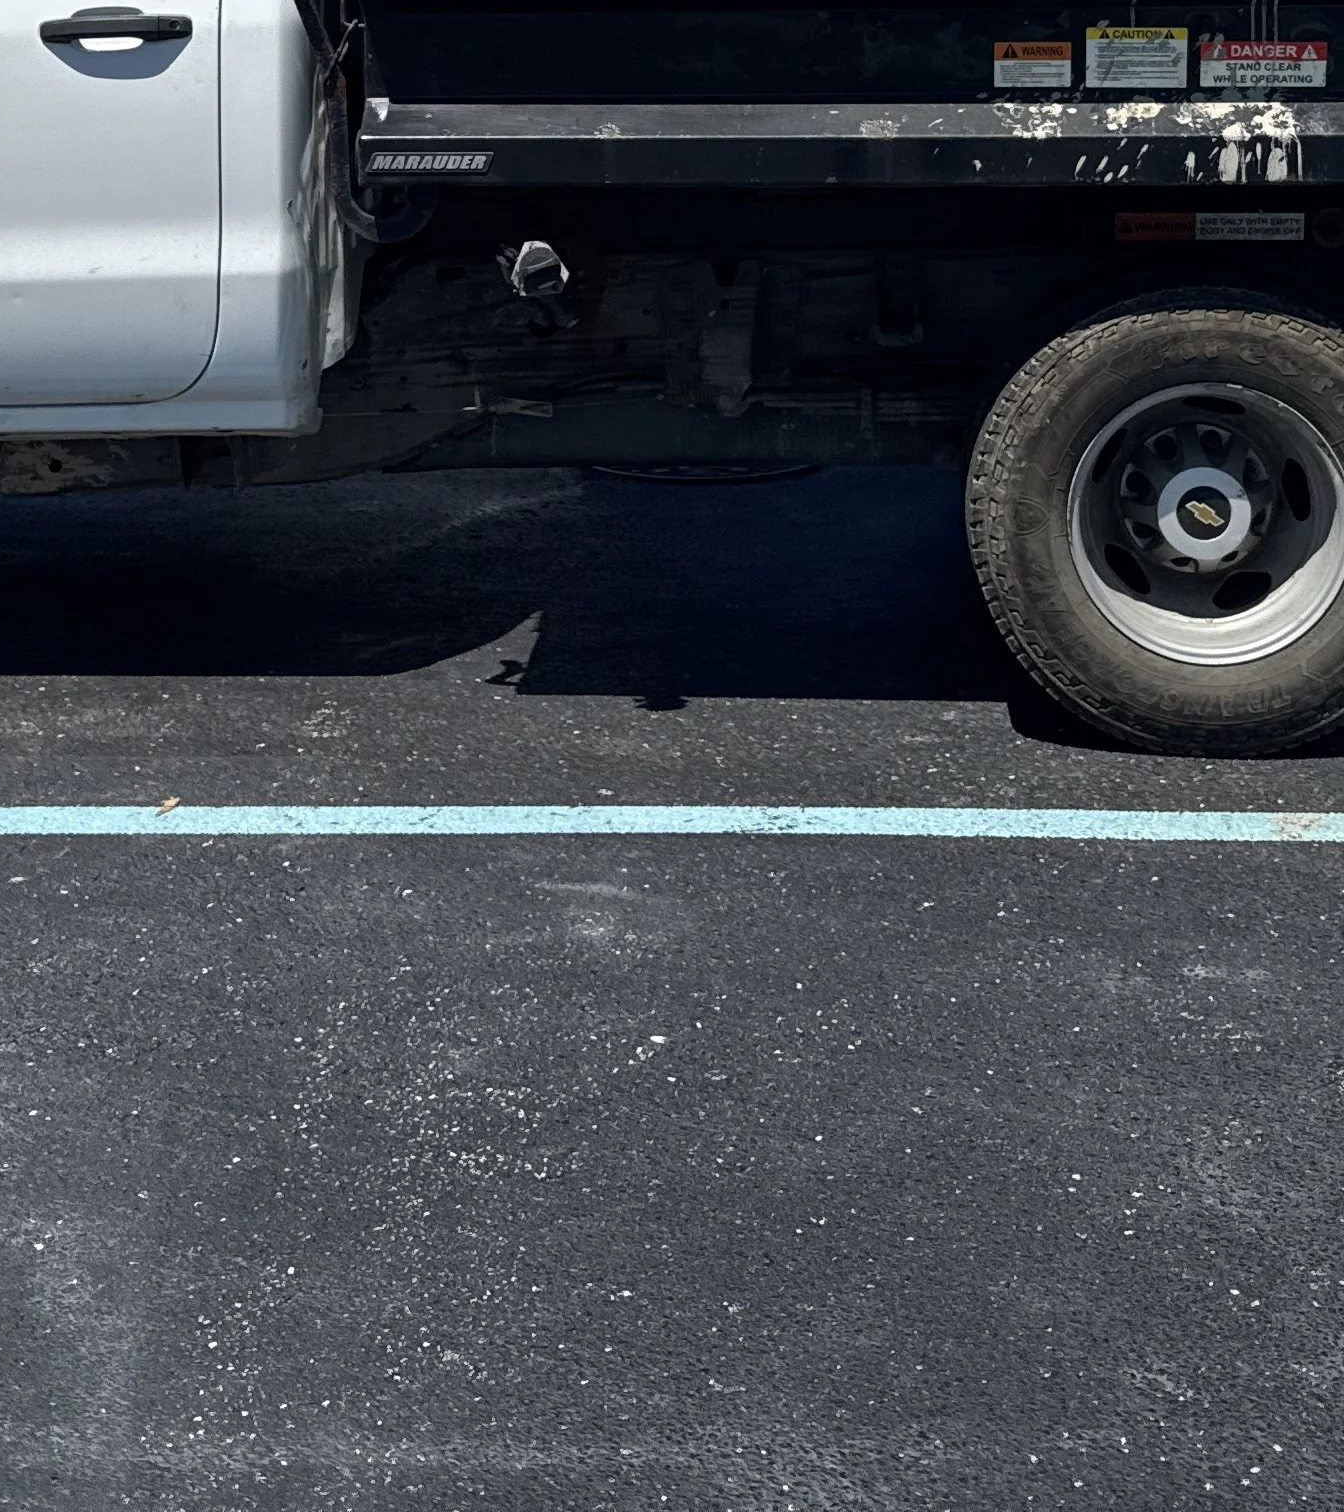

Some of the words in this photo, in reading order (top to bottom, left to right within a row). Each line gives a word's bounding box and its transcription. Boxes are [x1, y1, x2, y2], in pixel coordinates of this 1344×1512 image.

[1021, 45, 1064, 57] WARNING
[1230, 45, 1297, 57] DANGER
[1225, 62, 1261, 72] STAND
[1264, 62, 1302, 72] CLEAR
[1213, 74, 1248, 84] WHLE
[1250, 74, 1313, 84] OPERATING
[371, 154, 488, 172] MARAUDER
[1220, 217, 1243, 226] ONLY
[1245, 217, 1268, 226] WITH
